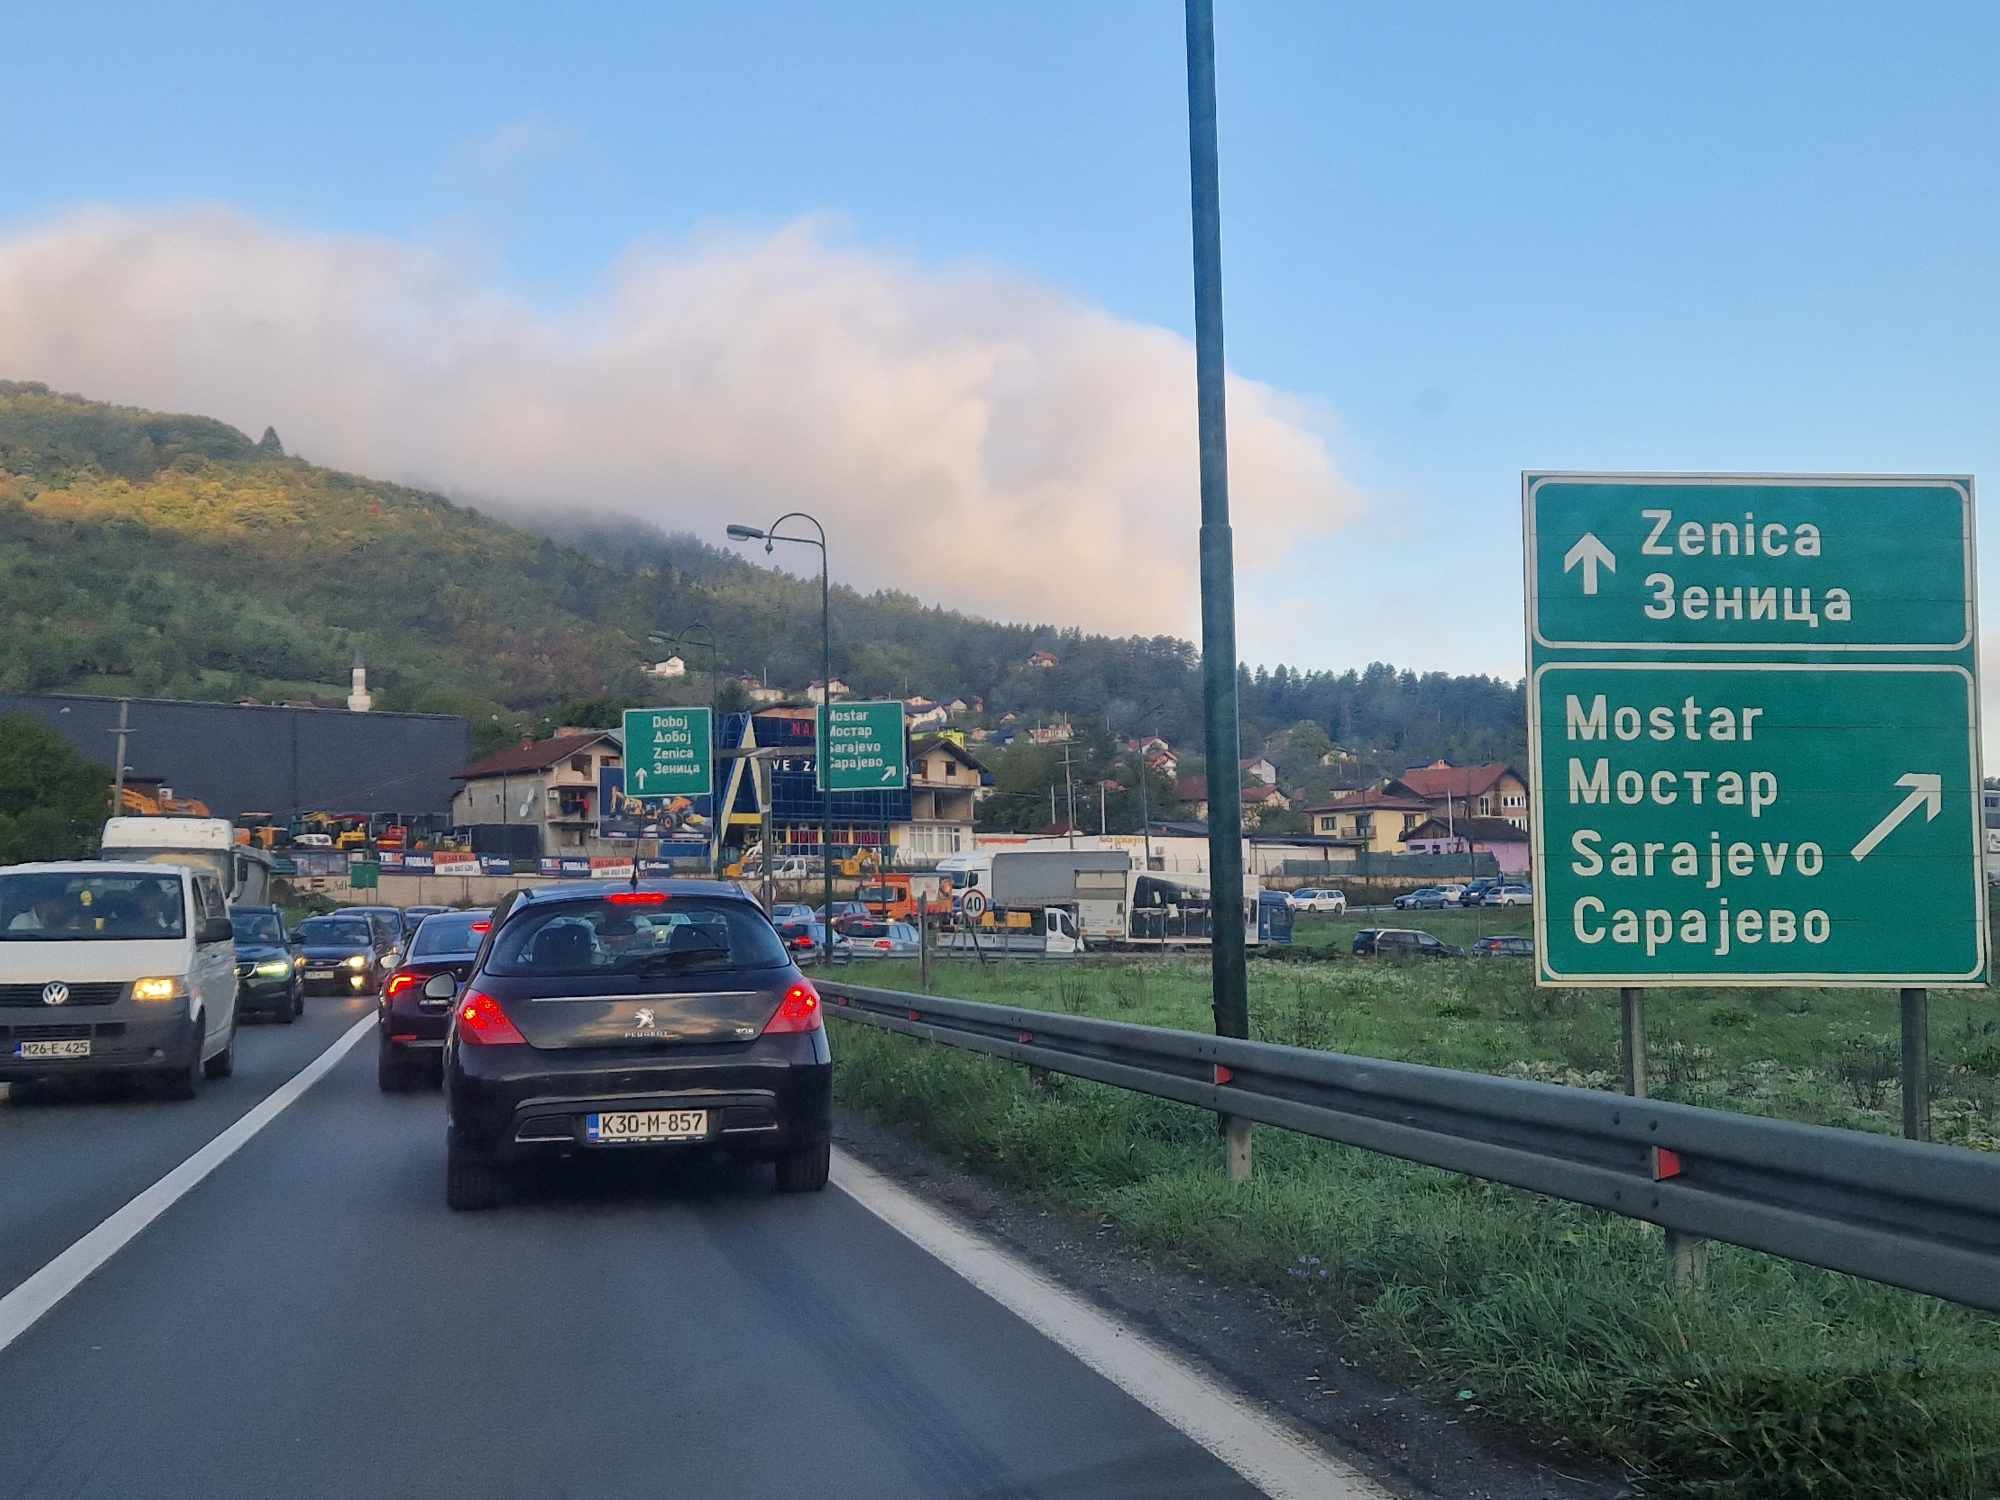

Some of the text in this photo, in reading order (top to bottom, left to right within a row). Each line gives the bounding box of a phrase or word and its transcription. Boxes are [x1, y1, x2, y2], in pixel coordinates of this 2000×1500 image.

[1640, 509, 1822, 558] Zenica
[1643, 572, 1852, 628] Зеница
[652, 715, 688, 729] Doboj
[1566, 694, 1764, 741] Mostar
[653, 730, 691, 744] Добој
[653, 747, 694, 759] Zenica
[653, 762, 700, 775] Зеница
[803, 760, 816, 772] Z
[1568, 758, 1778, 818] Мостар
[1571, 829, 1824, 889] Sarajevo
[966, 897, 981, 911] 40
[1573, 897, 1831, 956] Сарајево
[22, 1041, 88, 1056] M26-E-425
[602, 1111, 704, 1134] K30-M-857
